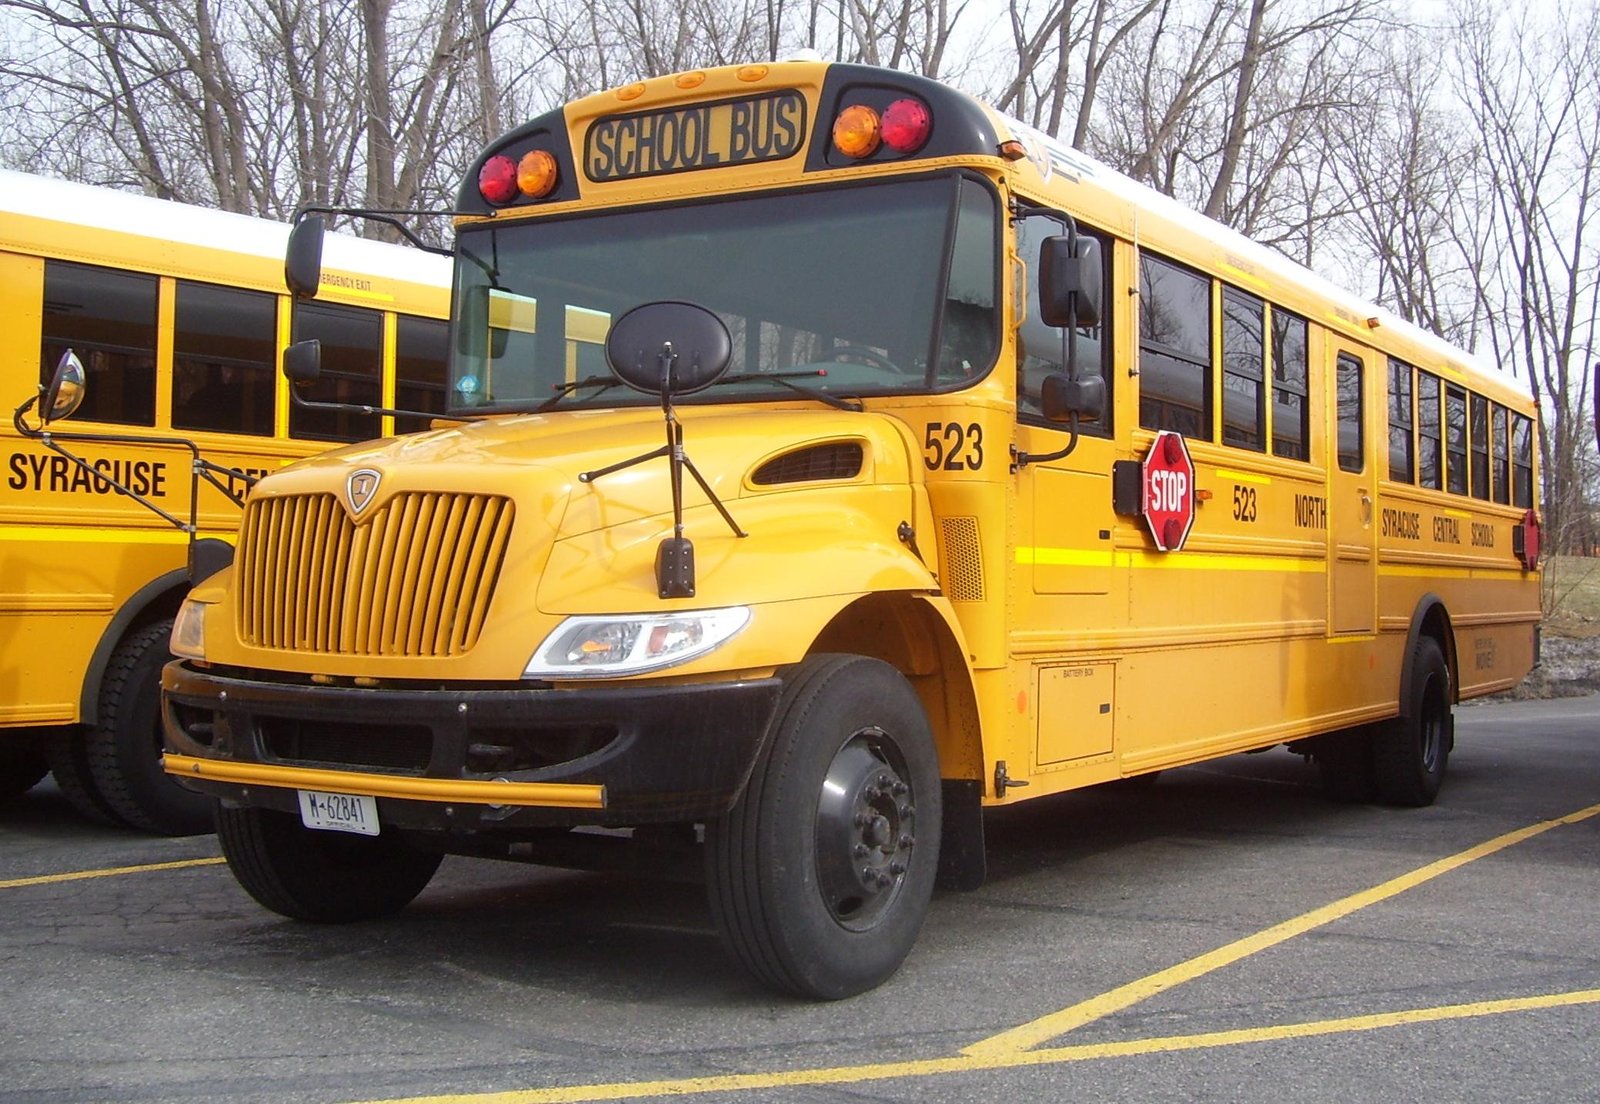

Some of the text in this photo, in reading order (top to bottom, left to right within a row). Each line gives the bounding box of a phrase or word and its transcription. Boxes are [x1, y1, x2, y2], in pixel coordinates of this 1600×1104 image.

[594, 95, 796, 178] SCHOOL BUS
[321, 273, 371, 291] ERGENCY EXIT
[924, 422, 983, 471] 523
[8, 453, 166, 497] SYRACUSE
[1151, 469, 1187, 512] STOP
[1233, 484, 1257, 522] 523
[1295, 493, 1494, 548] NORTH SYRACUSE CENTRAL SCHOOLS
